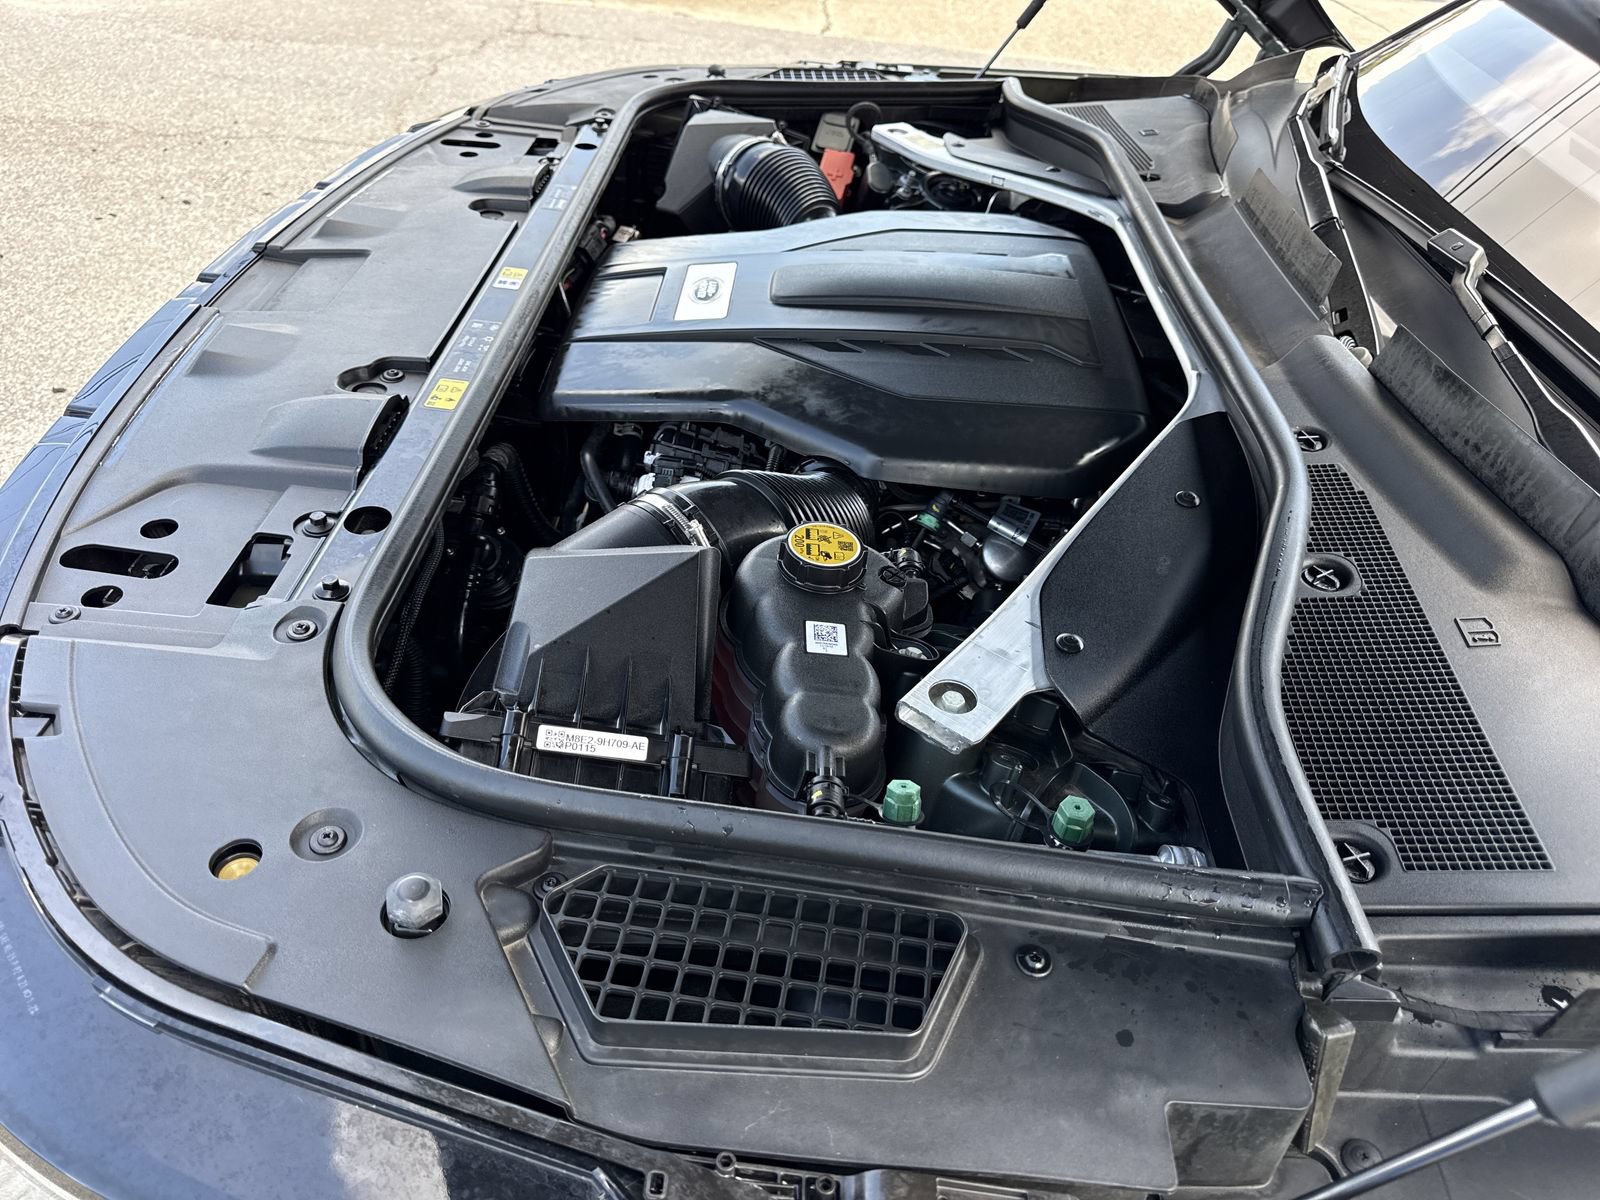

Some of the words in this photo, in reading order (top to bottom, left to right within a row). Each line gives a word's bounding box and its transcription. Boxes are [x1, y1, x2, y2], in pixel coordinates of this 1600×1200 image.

[795, 535, 804, 547] 200
[565, 741, 596, 753] P0115
[566, 734, 645, 751] M8E2-9H709-AE
